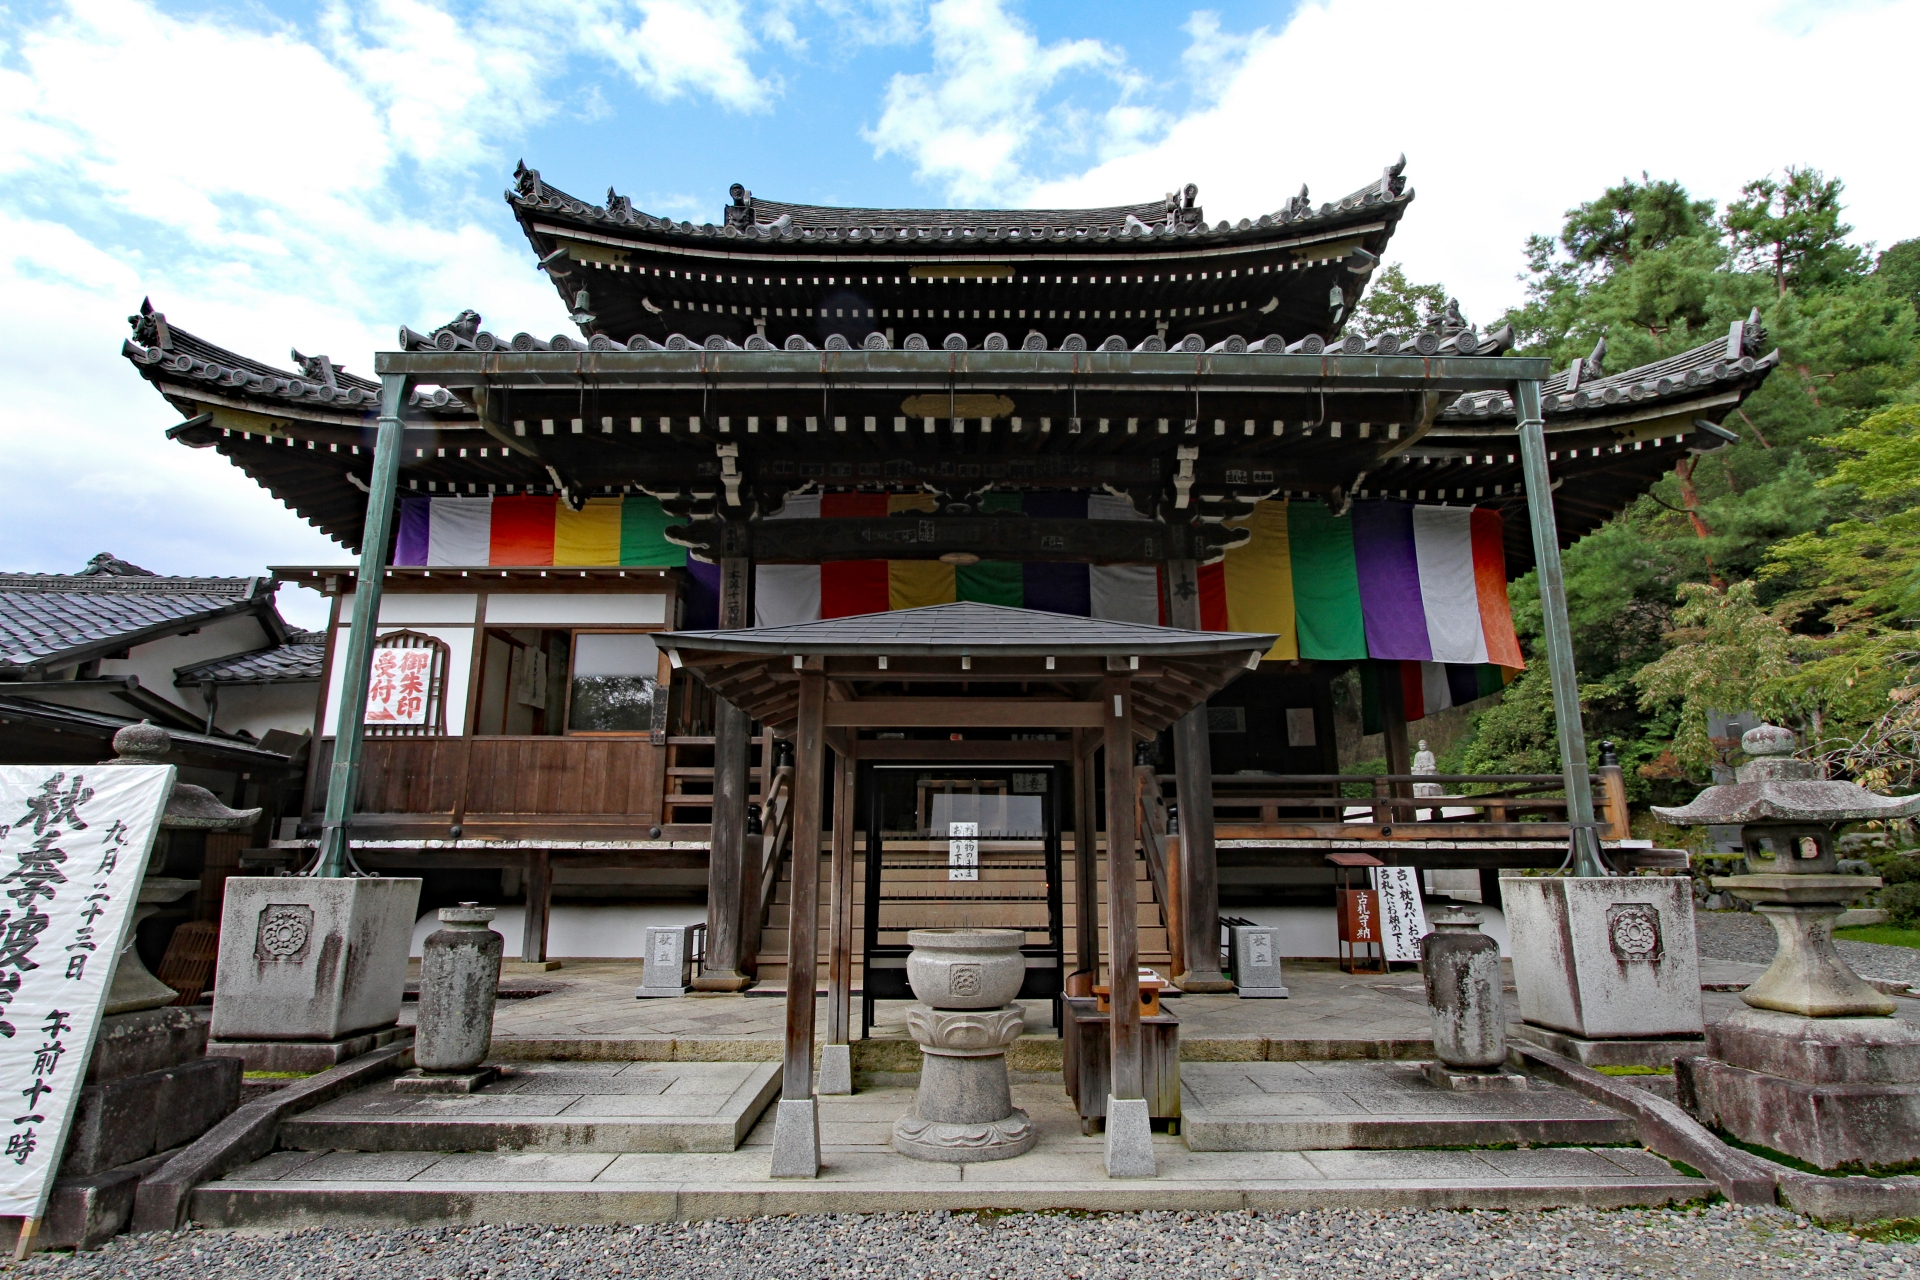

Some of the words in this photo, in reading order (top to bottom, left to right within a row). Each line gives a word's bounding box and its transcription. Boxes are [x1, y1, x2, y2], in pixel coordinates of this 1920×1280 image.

[369, 650, 397, 704] 受付
[396, 651, 429, 720] 御朱印
[952, 824, 964, 878] おり下い
[64, 819, 128, 981] 九月二十三日
[1356, 891, 1371, 940] 古札守納
[1380, 867, 1407, 960] 古札入にお納め下さい
[657, 933, 673, 963] 杖立
[1252, 934, 1268, 963] 杖立
[5, 1009, 72, 1165] 午前十一時
